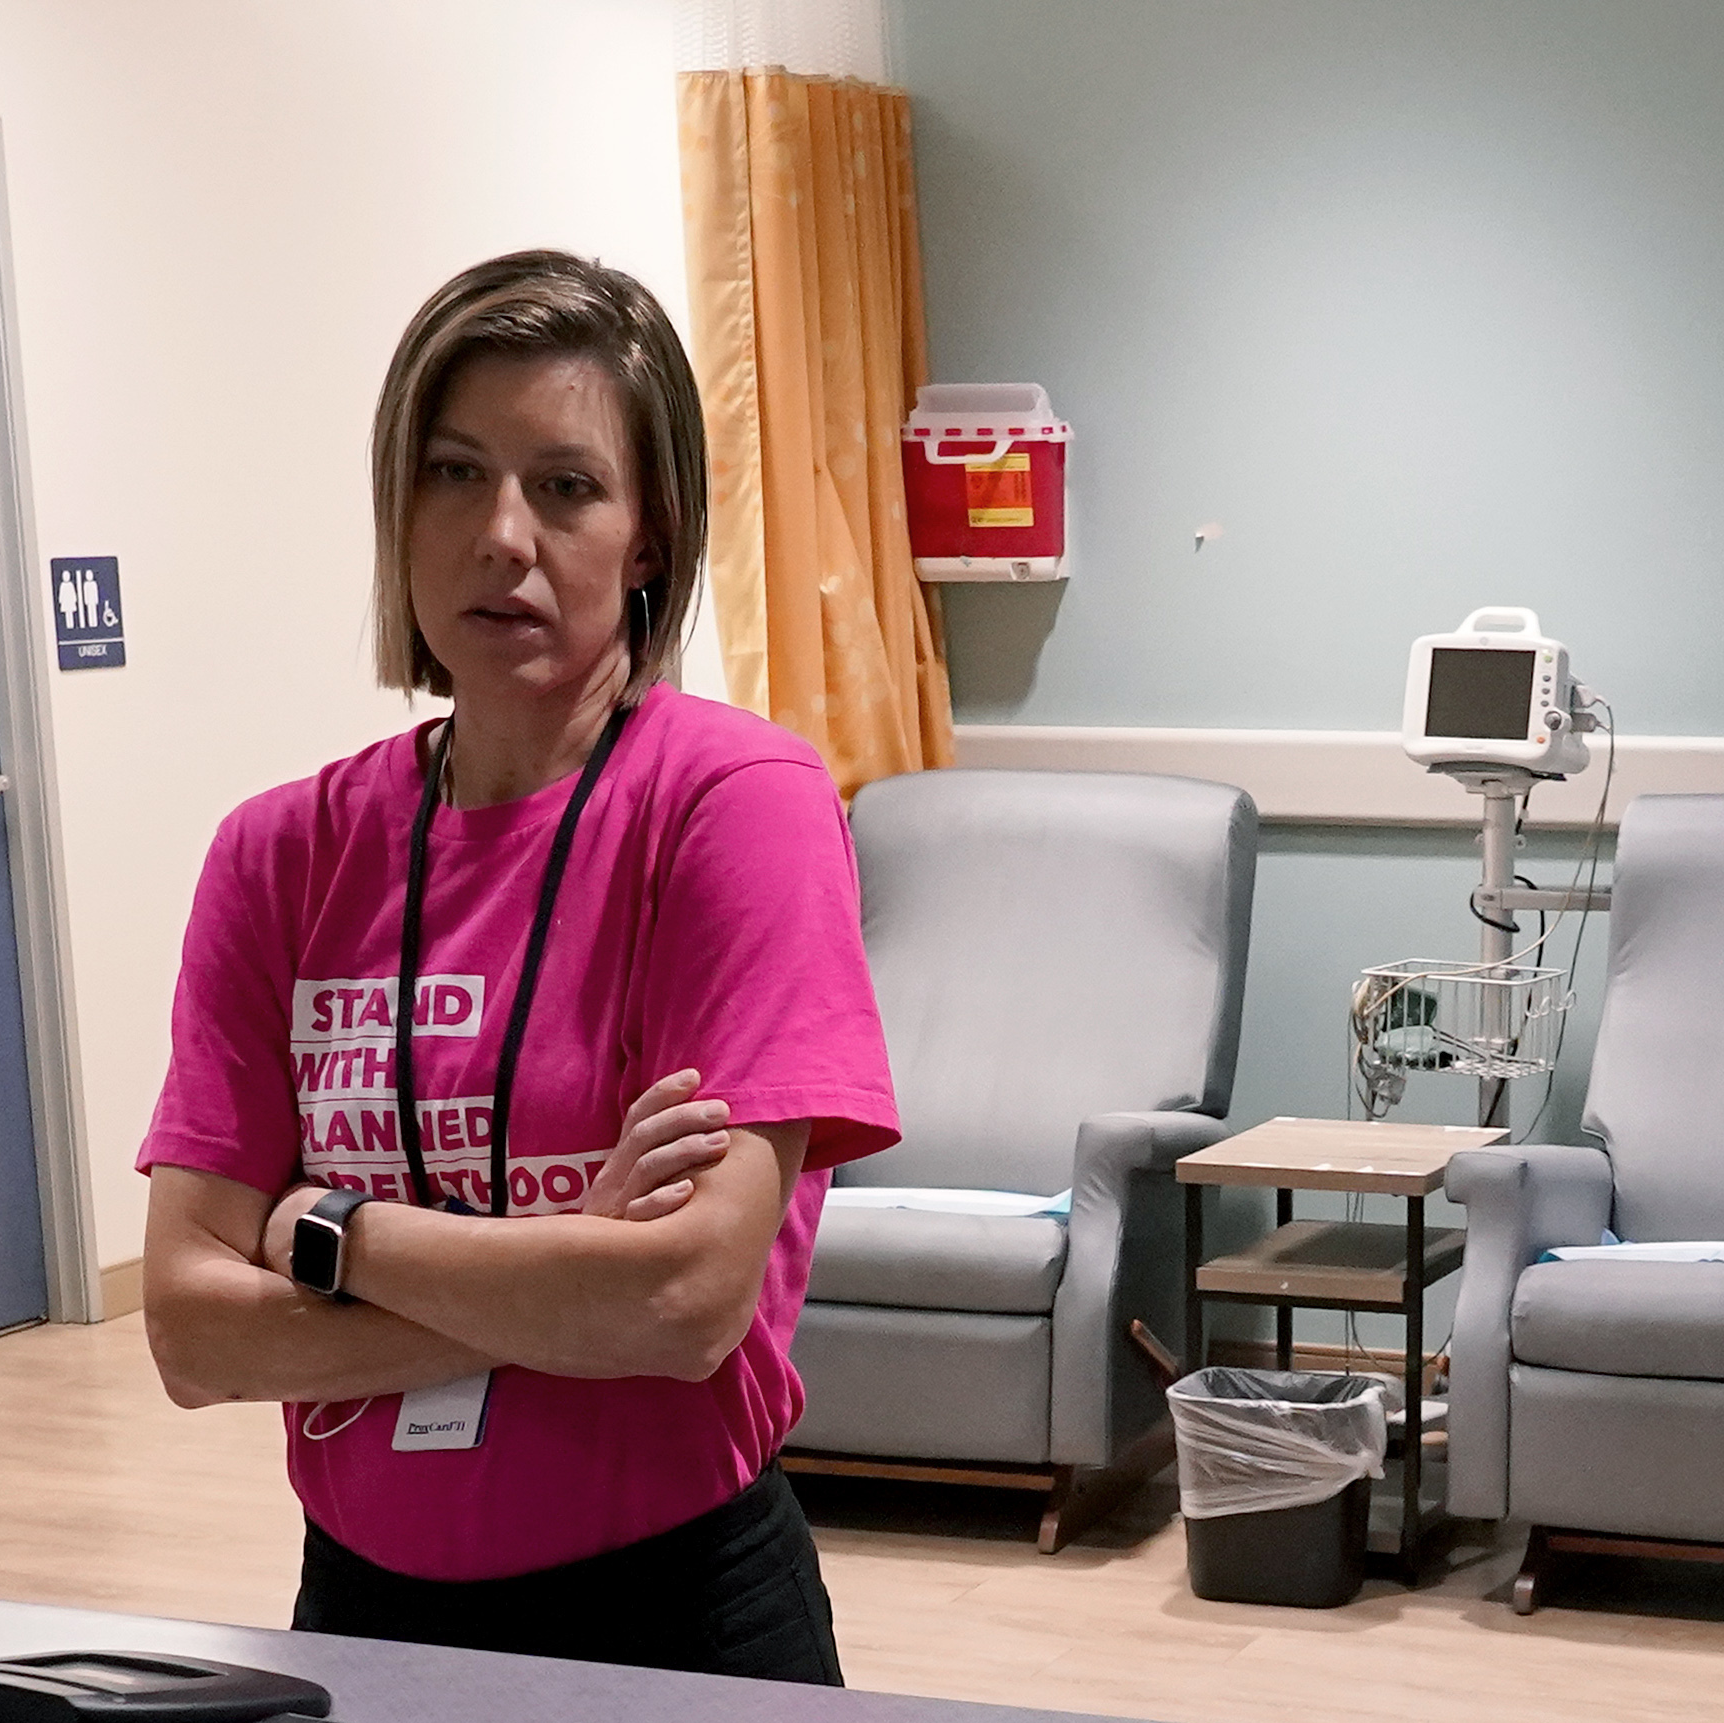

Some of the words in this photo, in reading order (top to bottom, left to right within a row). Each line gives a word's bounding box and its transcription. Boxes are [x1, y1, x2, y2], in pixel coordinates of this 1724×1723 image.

[78, 644, 107, 657] UNISEX
[311, 984, 473, 1032] STAND
[290, 1047, 397, 1092] WITH
[308, 1162, 605, 1207] ENTHOO
